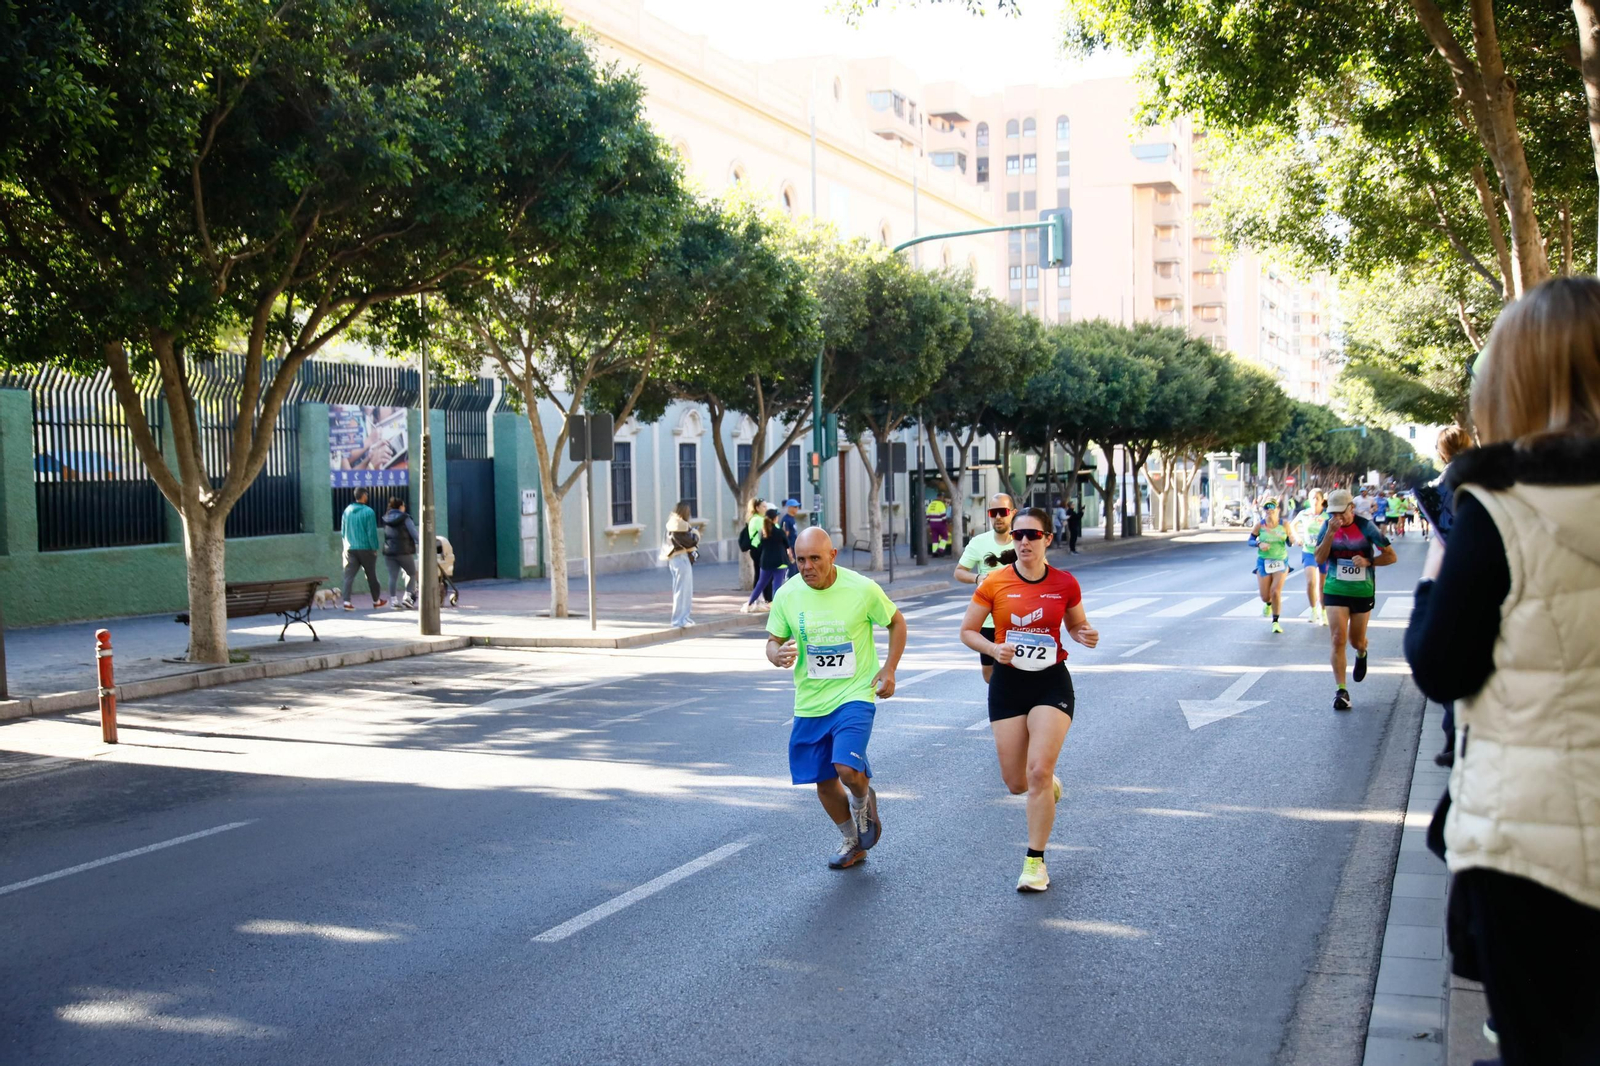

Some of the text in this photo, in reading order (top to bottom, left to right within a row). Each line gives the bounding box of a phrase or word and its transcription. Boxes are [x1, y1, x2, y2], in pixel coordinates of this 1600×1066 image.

[1341, 566, 1361, 575] 500
[807, 625, 845, 634] contra el
[808, 634, 846, 643] cáncer
[1015, 644, 1047, 660] 672
[816, 655, 845, 668] 327
